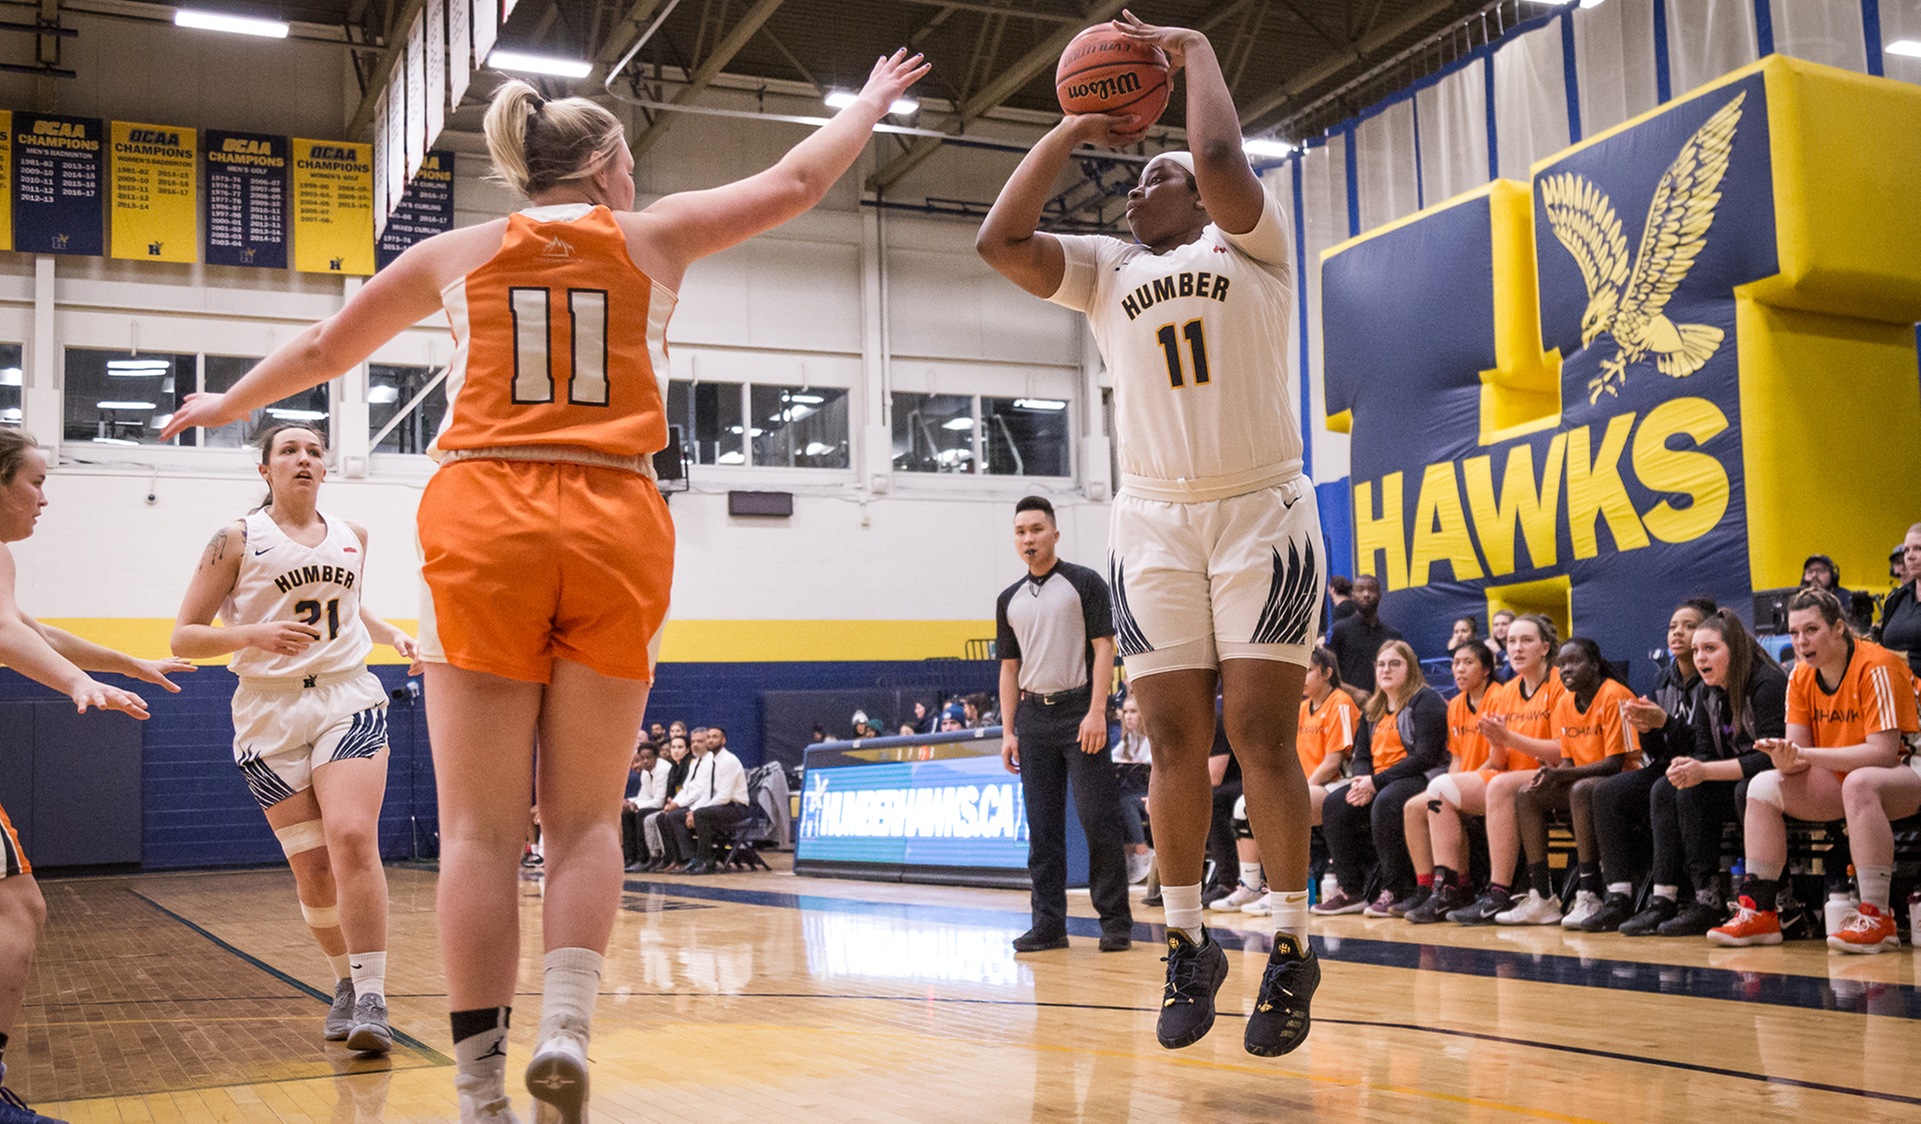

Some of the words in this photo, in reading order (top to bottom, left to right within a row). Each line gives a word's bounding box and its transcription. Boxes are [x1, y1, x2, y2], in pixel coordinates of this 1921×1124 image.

[1068, 71, 1142, 100] Wilson
[33, 120, 85, 138] OCAA
[129, 128, 180, 146] OCAA
[18, 133, 99, 151] CHAMPIONS
[222, 138, 271, 156] OCAA
[26, 147, 49, 156] MEN'S
[50, 150, 93, 159] BADMINTON
[115, 143, 193, 159] CHAMPIONS
[208, 151, 285, 167] CHAMPIONS
[310, 145, 357, 162] OCAA
[62, 162, 96, 170] 2013-14
[117, 156, 151, 165] WOMEN'S
[227, 165, 249, 173] MEN'S
[297, 159, 370, 173] CHAMPIONS
[20, 167, 54, 176] 2009-10
[62, 170, 96, 179] 2014-15
[416, 170, 452, 182] PIONS
[20, 176, 54, 185] 2010-11
[62, 179, 96, 188] 2015-16
[20, 185, 54, 194] 2011-12
[62, 188, 95, 197] 2016-17
[20, 194, 54, 203] 2012-13
[1121, 272, 1230, 321] HUMBER
[509, 286, 610, 407] 11
[1155, 317, 1212, 390] 11
[1354, 396, 1730, 592] HAWKS
[274, 565, 355, 594] HUMBER
[295, 599, 340, 642] 21
[820, 784, 1014, 838] HUMBERHAWKS.CA
